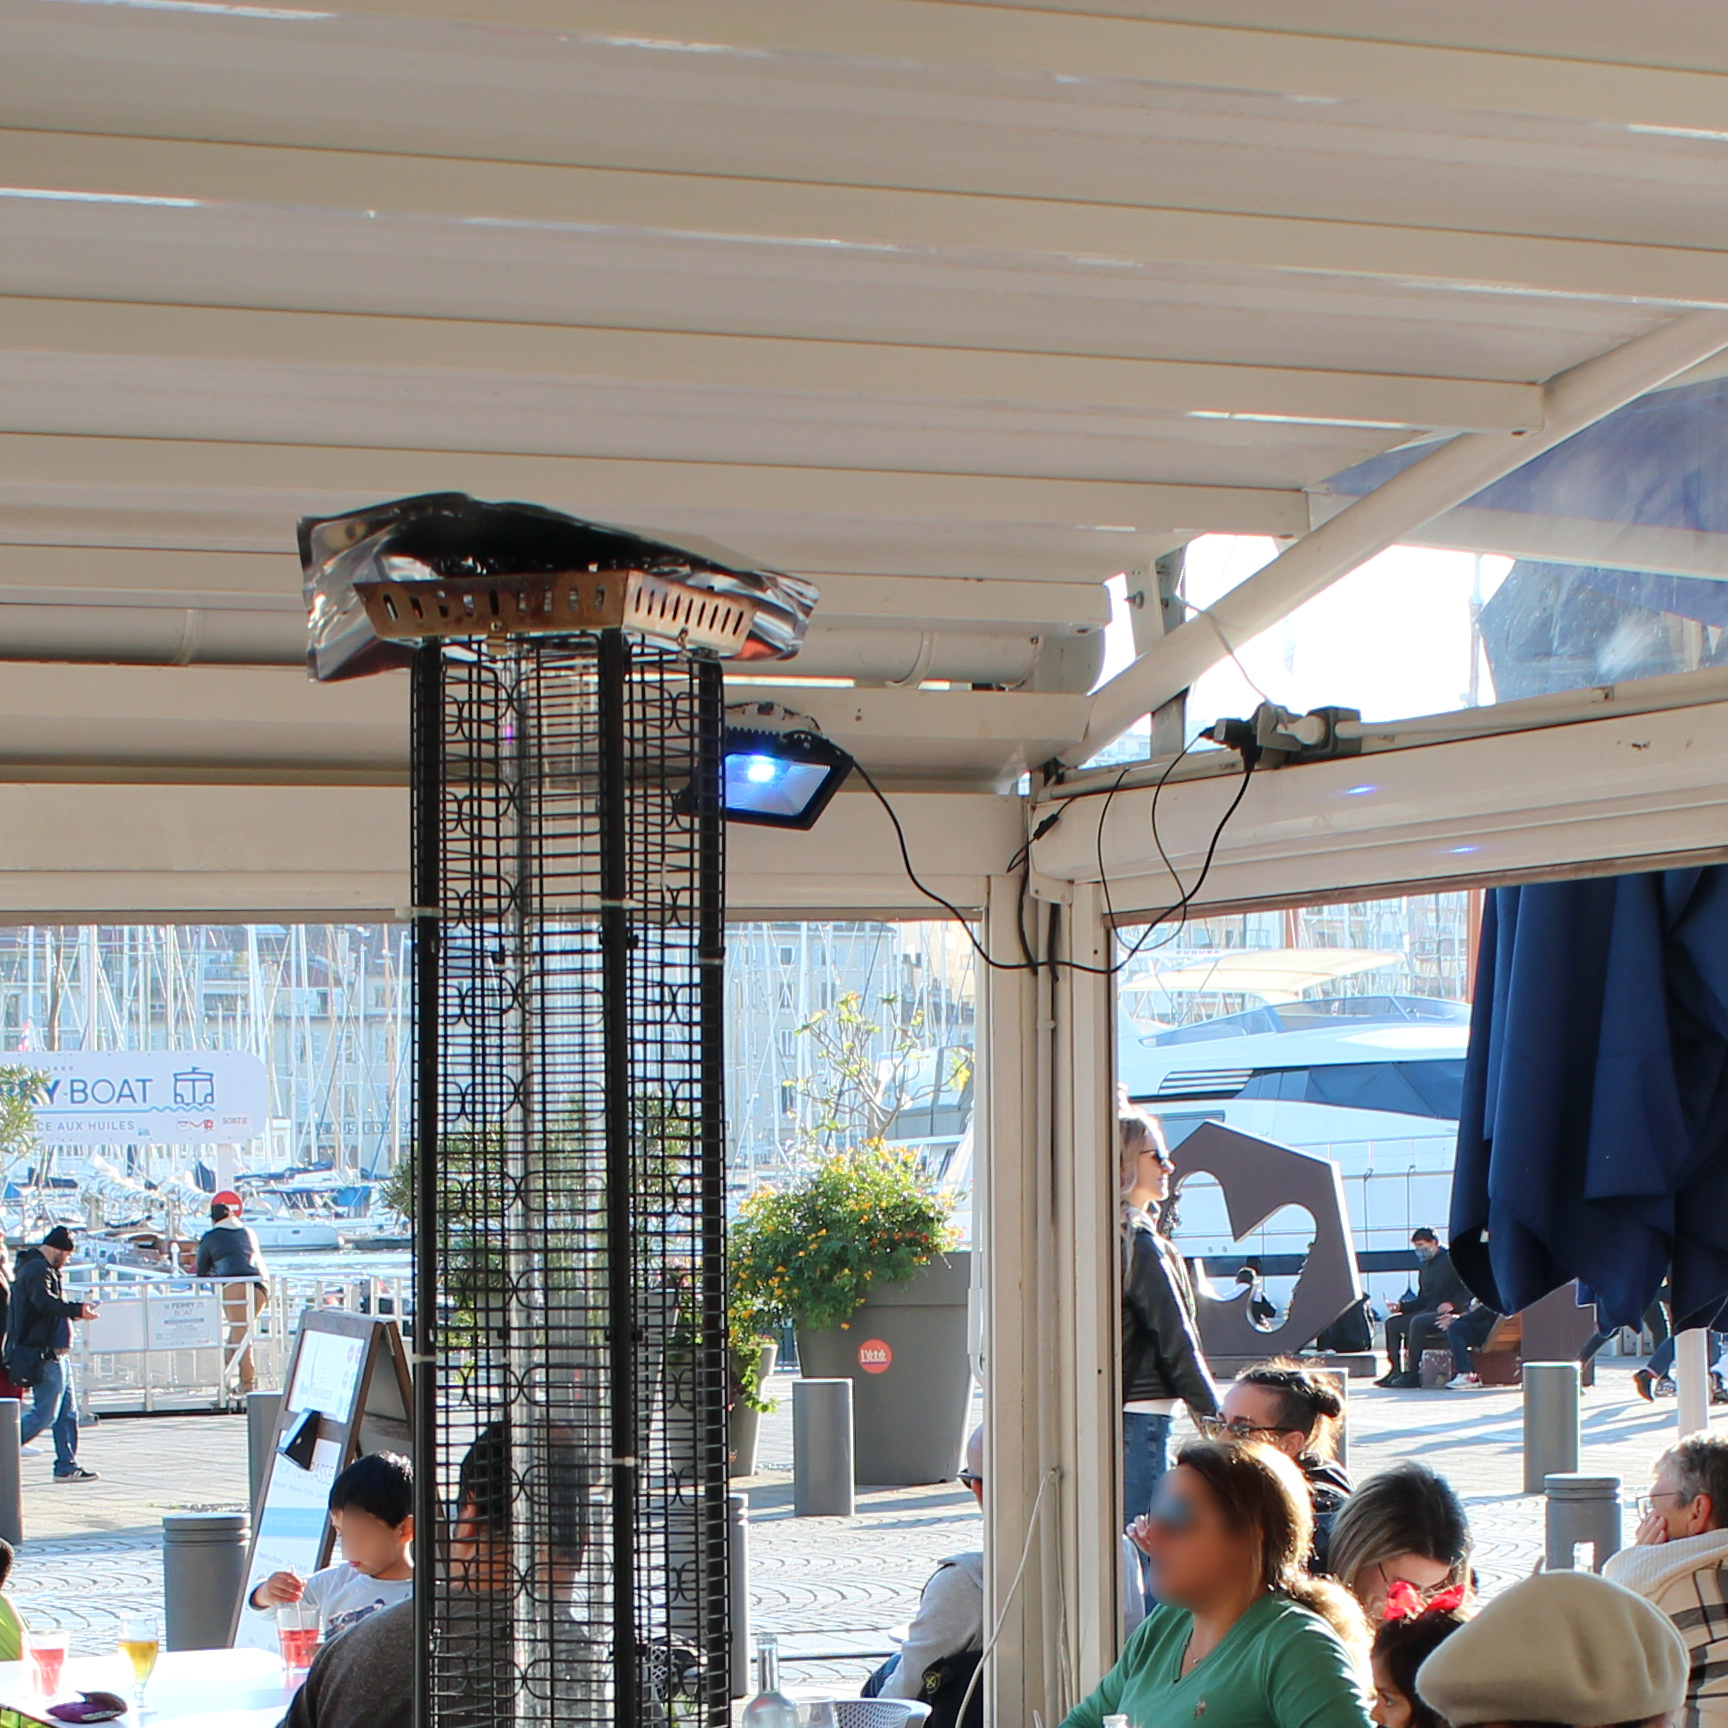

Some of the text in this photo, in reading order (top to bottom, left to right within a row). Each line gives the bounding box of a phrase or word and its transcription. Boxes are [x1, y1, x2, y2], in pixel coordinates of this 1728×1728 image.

[57, 1121, 84, 1132] AUX
[88, 1120, 135, 1131] HUILES
[222, 1116, 248, 1126] SORTIE
